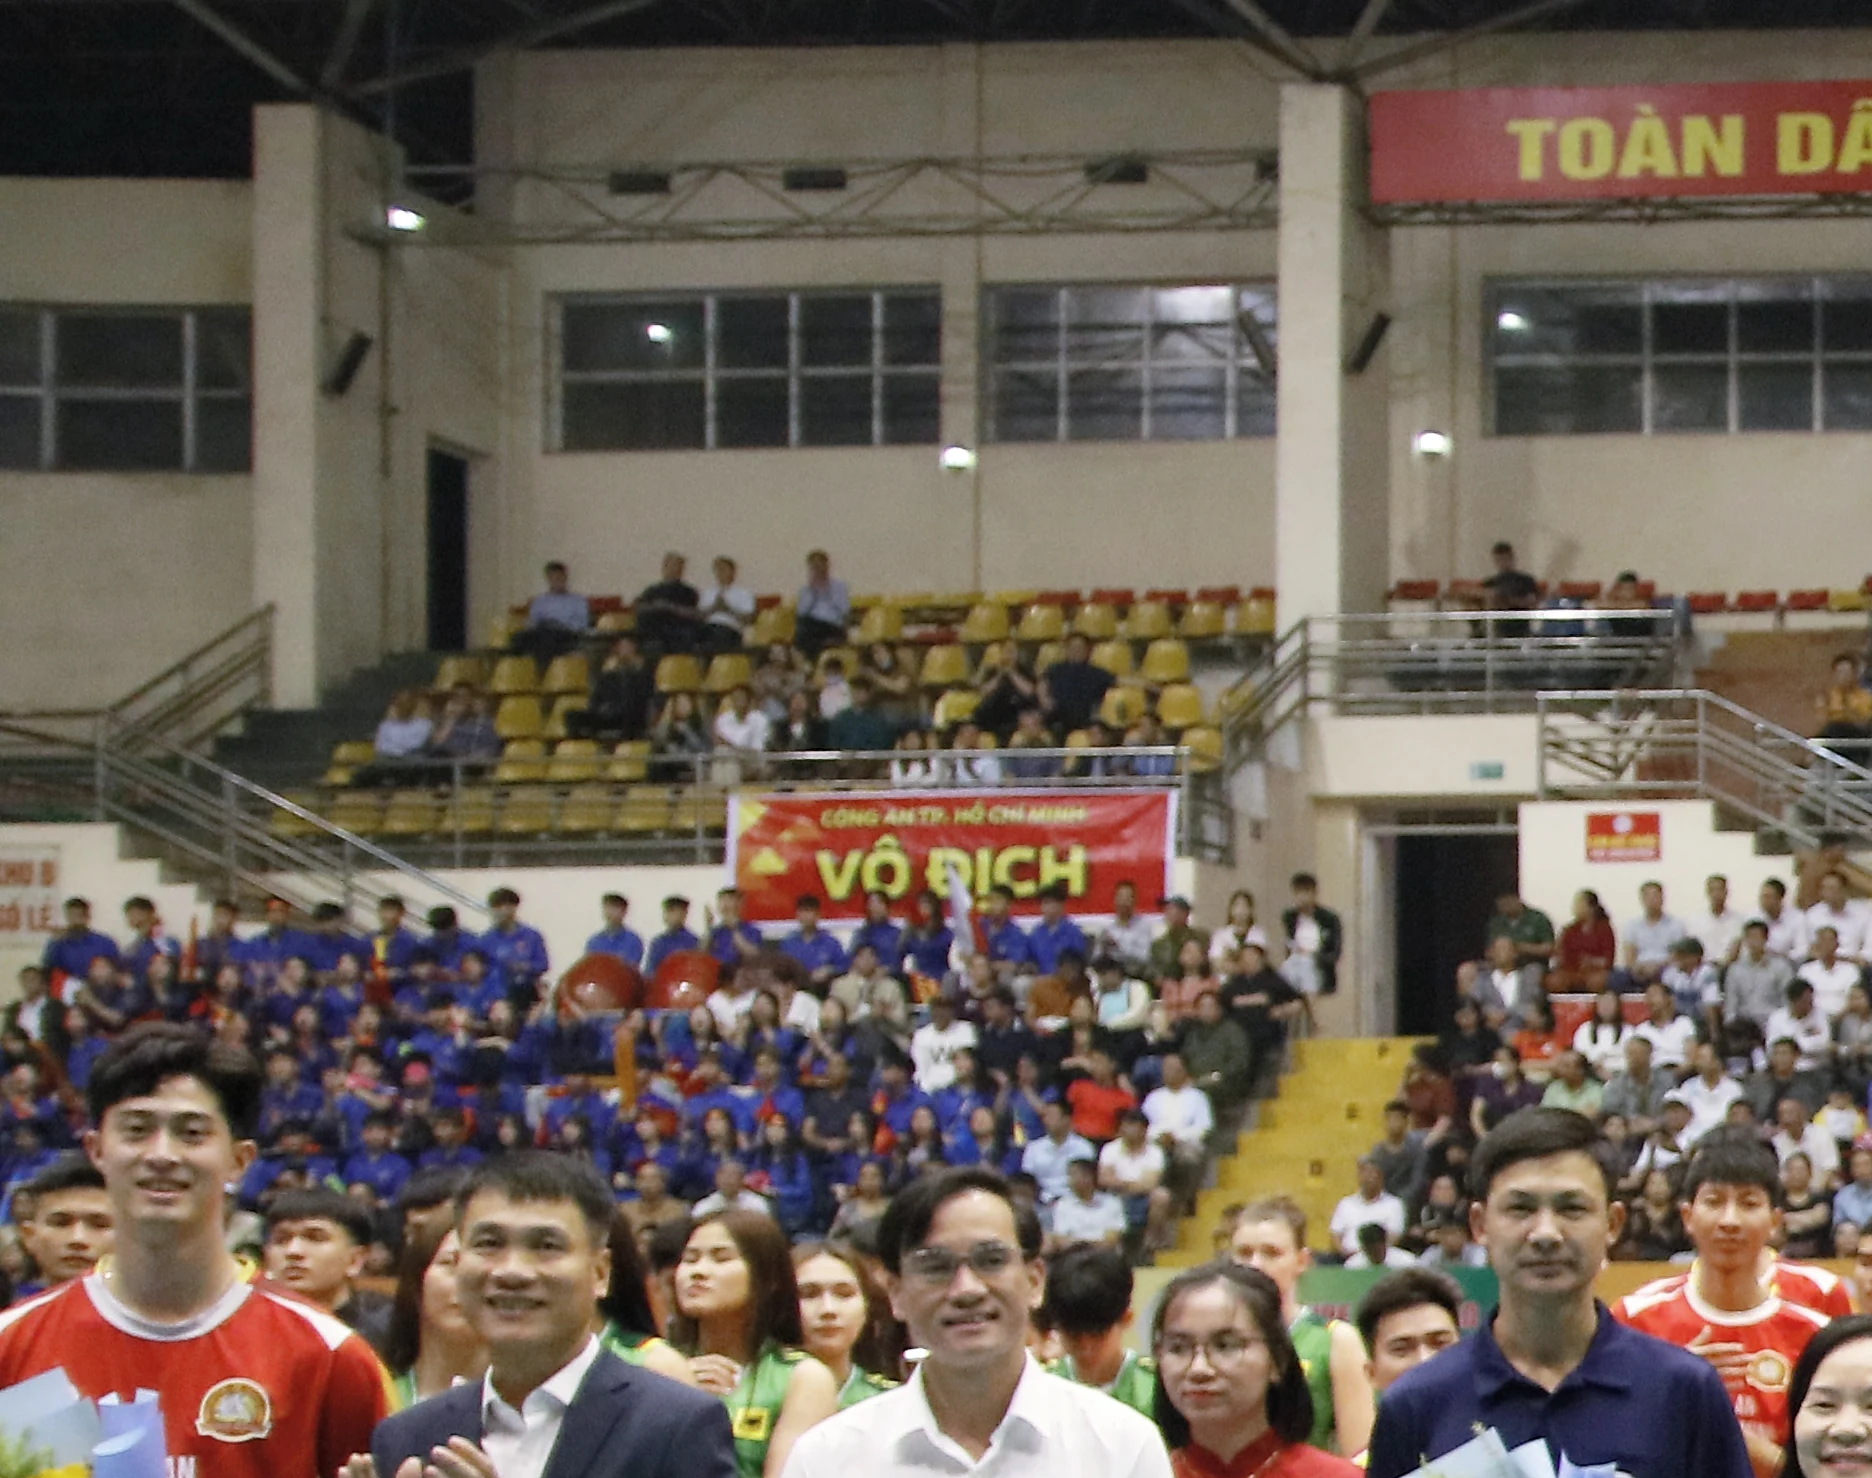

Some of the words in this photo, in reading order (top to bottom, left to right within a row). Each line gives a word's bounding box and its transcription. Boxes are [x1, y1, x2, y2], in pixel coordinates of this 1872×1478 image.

[1509, 103, 1745, 180] TOÀN
[815, 834, 911, 900] VÔ
[925, 844, 1088, 912] ĐỊCH
